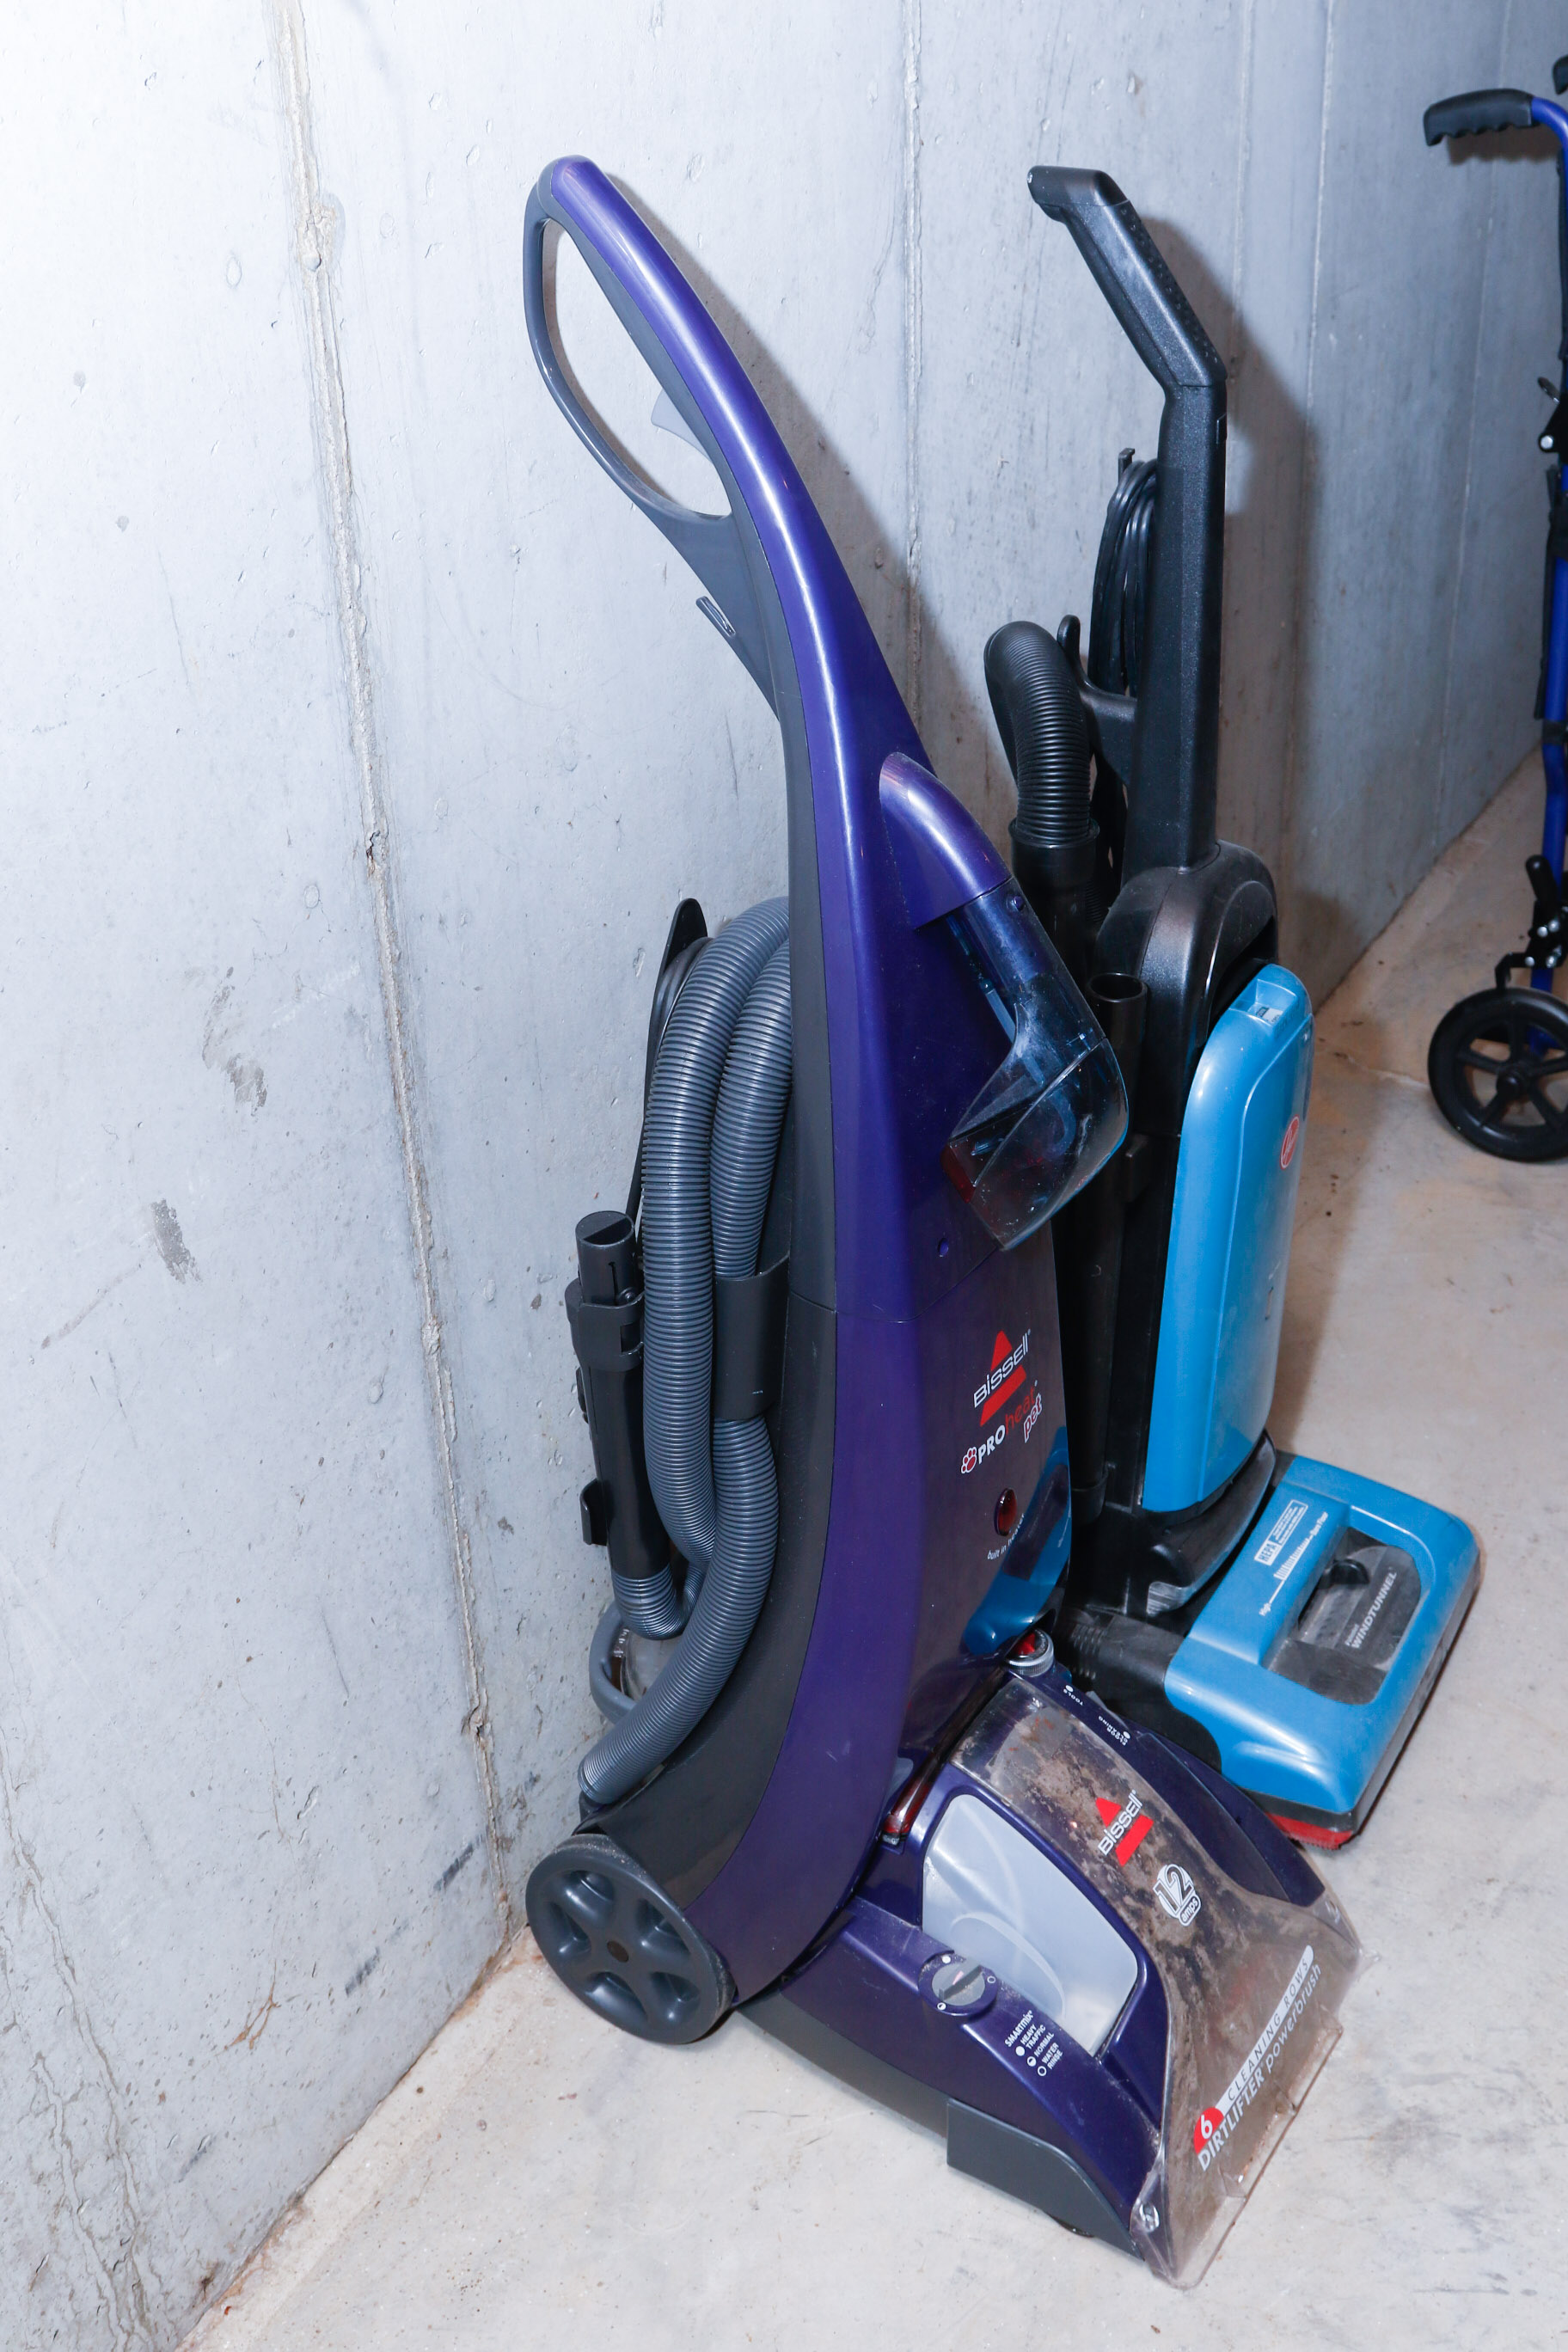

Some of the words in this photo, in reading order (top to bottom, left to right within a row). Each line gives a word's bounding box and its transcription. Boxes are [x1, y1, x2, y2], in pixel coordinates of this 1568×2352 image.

[1023, 1393, 1043, 1443] pet
[1001, 1545, 1007, 1554] in
[1258, 1543, 1277, 1562] HEPA
[1351, 1571, 1397, 1649] WINDTUNNEL
[1063, 1688, 1083, 1706] TOOLS
[1098, 1715, 1128, 1743] CLEANING
[1106, 1726, 1127, 1746] FLOOR
[1153, 1864, 1195, 1914] 12
[1181, 1897, 1198, 1922] amps
[1020, 2024, 1037, 2045] HEAVY
[1026, 2024, 1046, 2049] TRAFFIC
[1034, 2032, 1055, 2057] NORMAL
[1041, 2043, 1059, 2064] WATER
[1047, 2049, 1063, 2070] RINSE
[1200, 2114, 1213, 2140] 6
[1228, 2012, 1282, 2101] CLEANING
[1283, 1958, 1309, 2009] ROWS
[1197, 2068, 1265, 2171] DIRTLIFTER
[1265, 1963, 1322, 2074] powerbrush
